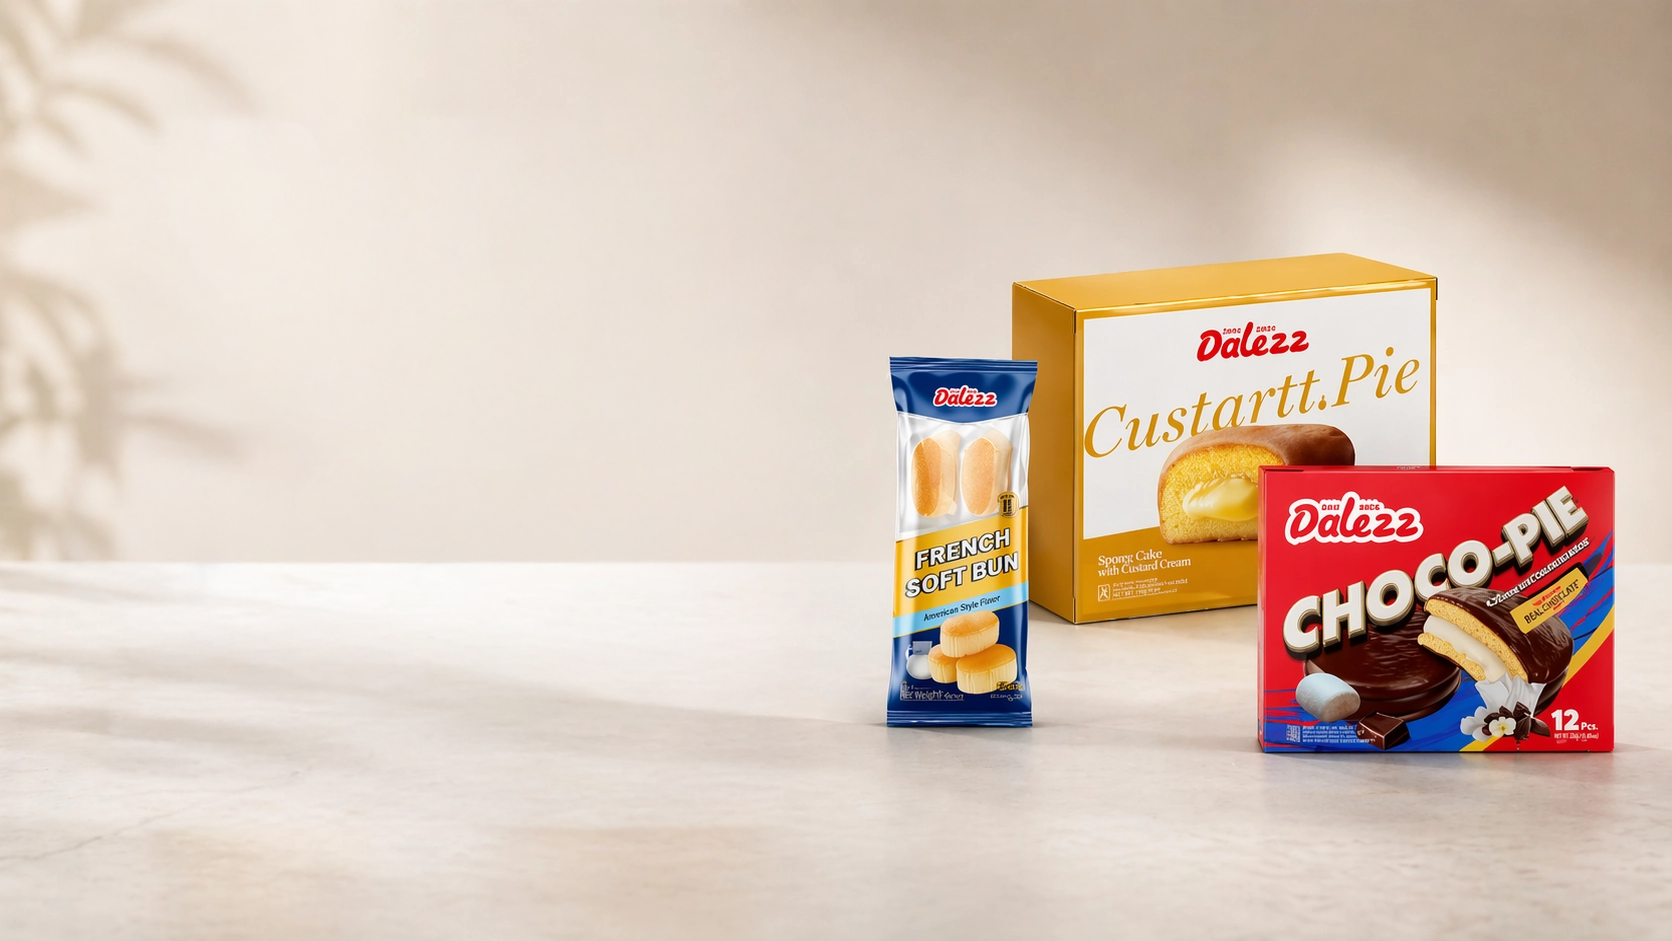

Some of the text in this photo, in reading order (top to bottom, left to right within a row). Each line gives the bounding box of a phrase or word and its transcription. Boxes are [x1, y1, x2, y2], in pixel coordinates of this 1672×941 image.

[1197, 321, 1309, 362] Dalezz
[934, 386, 997, 406] Dalezz
[1288, 495, 1420, 541] Dalezz
[915, 528, 1010, 570] FRENCH
[1098, 558, 1191, 577] with Custard Cream
[1136, 549, 1162, 560] Cake
[1283, 485, 1589, 652] CHOCO-PIE
[905, 552, 1019, 598] SOFT BUN
[1551, 709, 1599, 731] 12 Pcs.
